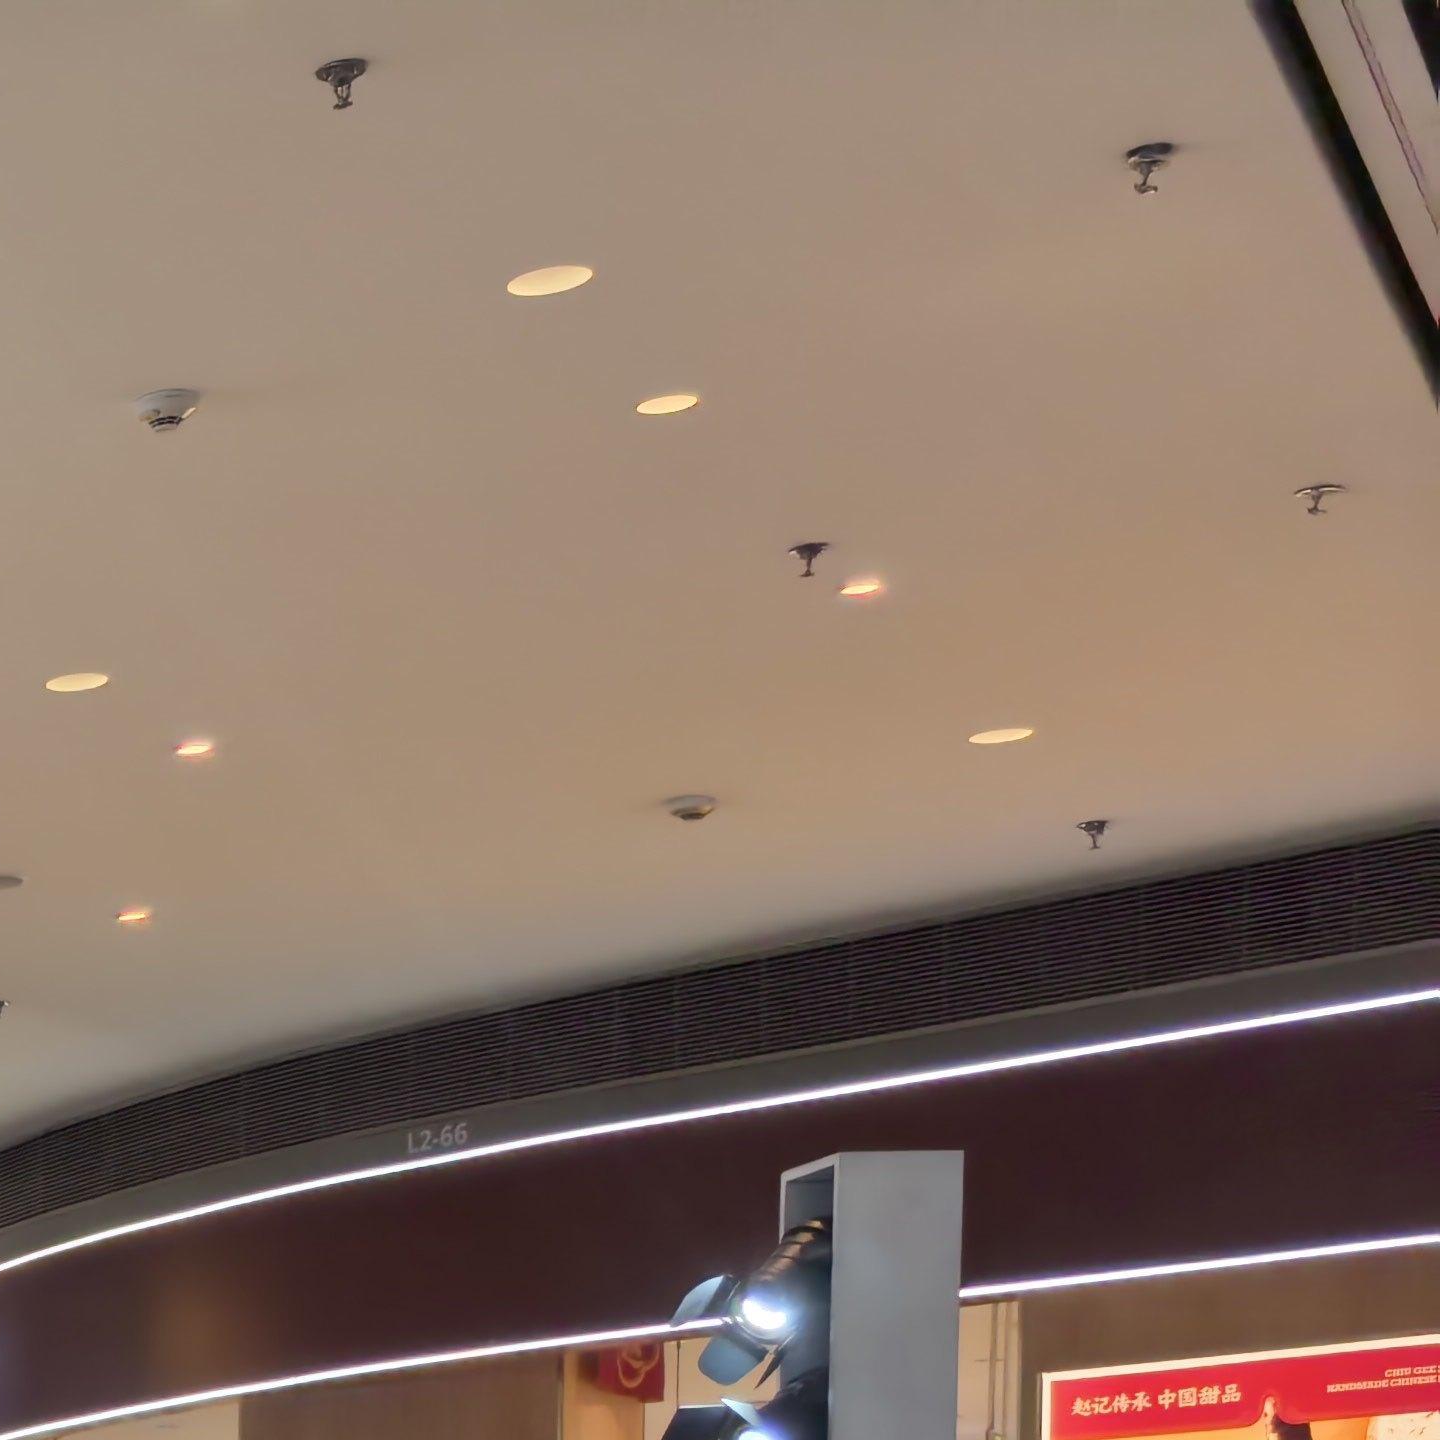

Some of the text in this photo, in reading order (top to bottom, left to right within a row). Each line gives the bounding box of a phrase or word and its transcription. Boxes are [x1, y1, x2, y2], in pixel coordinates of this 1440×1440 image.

[407, 1123, 469, 1154] L2-66
[1071, 1383, 1242, 1417] 赵记传承 中国甜品
